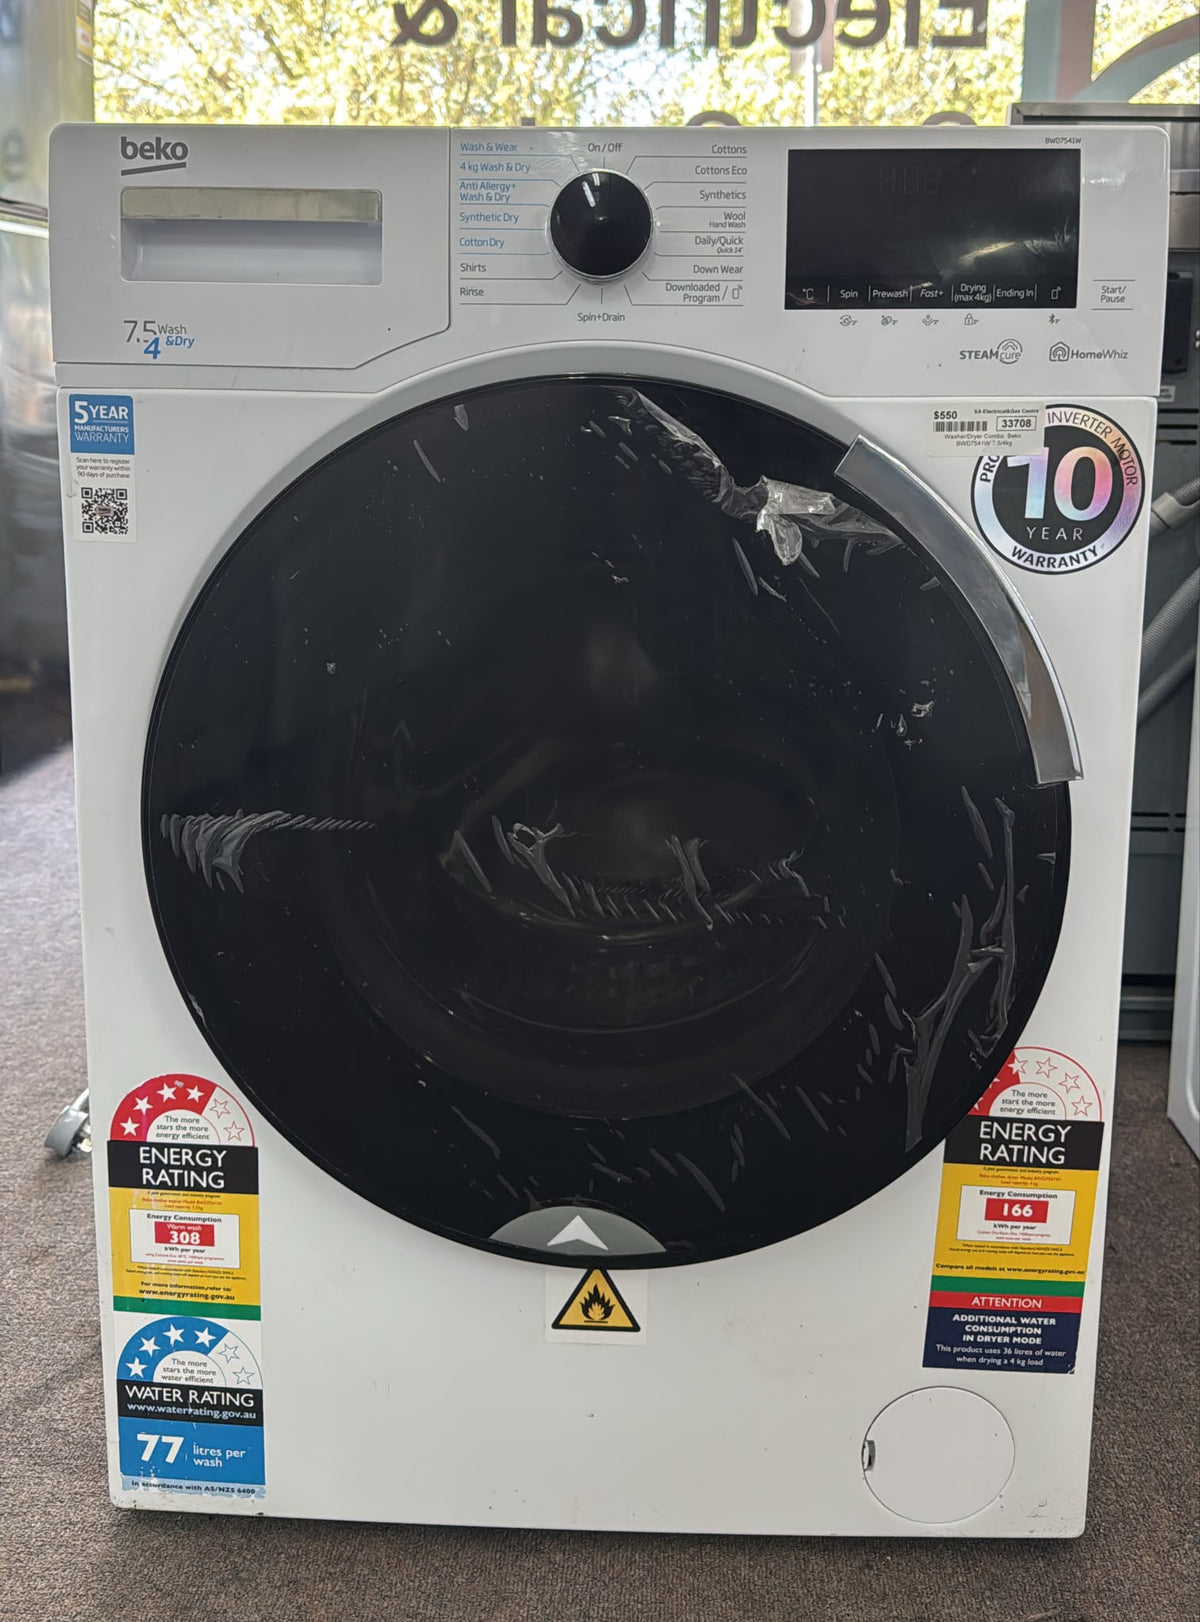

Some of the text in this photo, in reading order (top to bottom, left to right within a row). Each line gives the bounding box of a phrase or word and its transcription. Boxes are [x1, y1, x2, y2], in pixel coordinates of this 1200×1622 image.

[121, 136, 188, 160] beko
[460, 143, 518, 152] Wash & Wear
[588, 143, 600, 152] On
[608, 143, 622, 152] Off
[712, 145, 747, 154] Cottons
[460, 163, 530, 173] 4 kg Wash & Dry
[695, 166, 747, 175] Cottons Eco
[460, 182, 517, 192] Anti Allergy+
[460, 193, 510, 203] Wash & Dry
[700, 190, 746, 200] Synthetics
[460, 212, 518, 224] Synthetic Dry
[724, 212, 745, 220] Wool
[460, 238, 504, 248] Cotton Dry
[695, 236, 743, 246] Daily/Quick
[460, 263, 486, 272] Shirts
[693, 265, 743, 273] Down Wear
[460, 287, 484, 296] Rinse
[666, 283, 720, 292] Downloaded
[960, 283, 986, 294] Drying
[1101, 285, 1126, 296] Start/
[683, 293, 720, 304] Program
[840, 288, 858, 300] Spin
[872, 289, 908, 298] Prewash
[920, 288, 944, 298] Fast+
[954, 292, 992, 304] (max 4kg)
[997, 288, 1034, 299] Ending In
[1101, 294, 1125, 303] Pause
[578, 313, 625, 323] Spin+Drain
[158, 324, 186, 334] Wash
[144, 336, 195, 360] 4 &Dry
[1071, 349, 1128, 360] HomeWhiz
[74, 401, 128, 424] 5 YEAR
[934, 411, 957, 420] $550
[1002, 419, 1032, 428] 33708
[75, 432, 129, 443] WARRANTY
[1048, 411, 1112, 439] INVERTER
[1111, 437, 1138, 485] MOTOR
[1007, 446, 1113, 521] 10
[1026, 526, 1083, 540] YEAR
[1011, 545, 1098, 568] WARRANTY
[1021, 1098, 1033, 1106] the
[1000, 1107, 1056, 1115] energy efficient
[156, 1132, 180, 1140] energy
[980, 1121, 1071, 1143] ENERGY
[139, 1146, 227, 1168] ENERGY
[980, 1143, 1065, 1165] RATING
[142, 1168, 224, 1189] RATING
[1008, 1191, 1058, 1199] Consumption
[1002, 1203, 1033, 1217] 166
[174, 1214, 222, 1223] Consumption
[170, 1231, 200, 1244] 308
[139, 1288, 235, 1300] www.energyrating.gov.au
[971, 1296, 1042, 1309] ATTENTION
[952, 1314, 1056, 1325] ADDITIONAL WATER
[965, 1324, 1042, 1334] CONSUMPTION
[963, 1334, 1042, 1345] IN DRYER MODE
[936, 1344, 951, 1352] This
[953, 1345, 983, 1355] product
[1003, 1347, 1012, 1355] 36
[1014, 1348, 1032, 1356] litres
[171, 1358, 207, 1368] The more
[979, 1356, 1001, 1366] drying
[1017, 1359, 1025, 1367] kg
[1028, 1358, 1044, 1366] load
[185, 1376, 214, 1384] efficient
[125, 1384, 254, 1407] WATER RATING
[127, 1403, 256, 1420] www.waterrating.gov.au
[137, 1433, 246, 1464] 77 litres per
[193, 1457, 223, 1467] wash
[142, 1481, 183, 1490] accordance
[185, 1483, 203, 1491] with
[204, 1485, 235, 1494] AS/NZS
[237, 1486, 256, 1494] 6400
